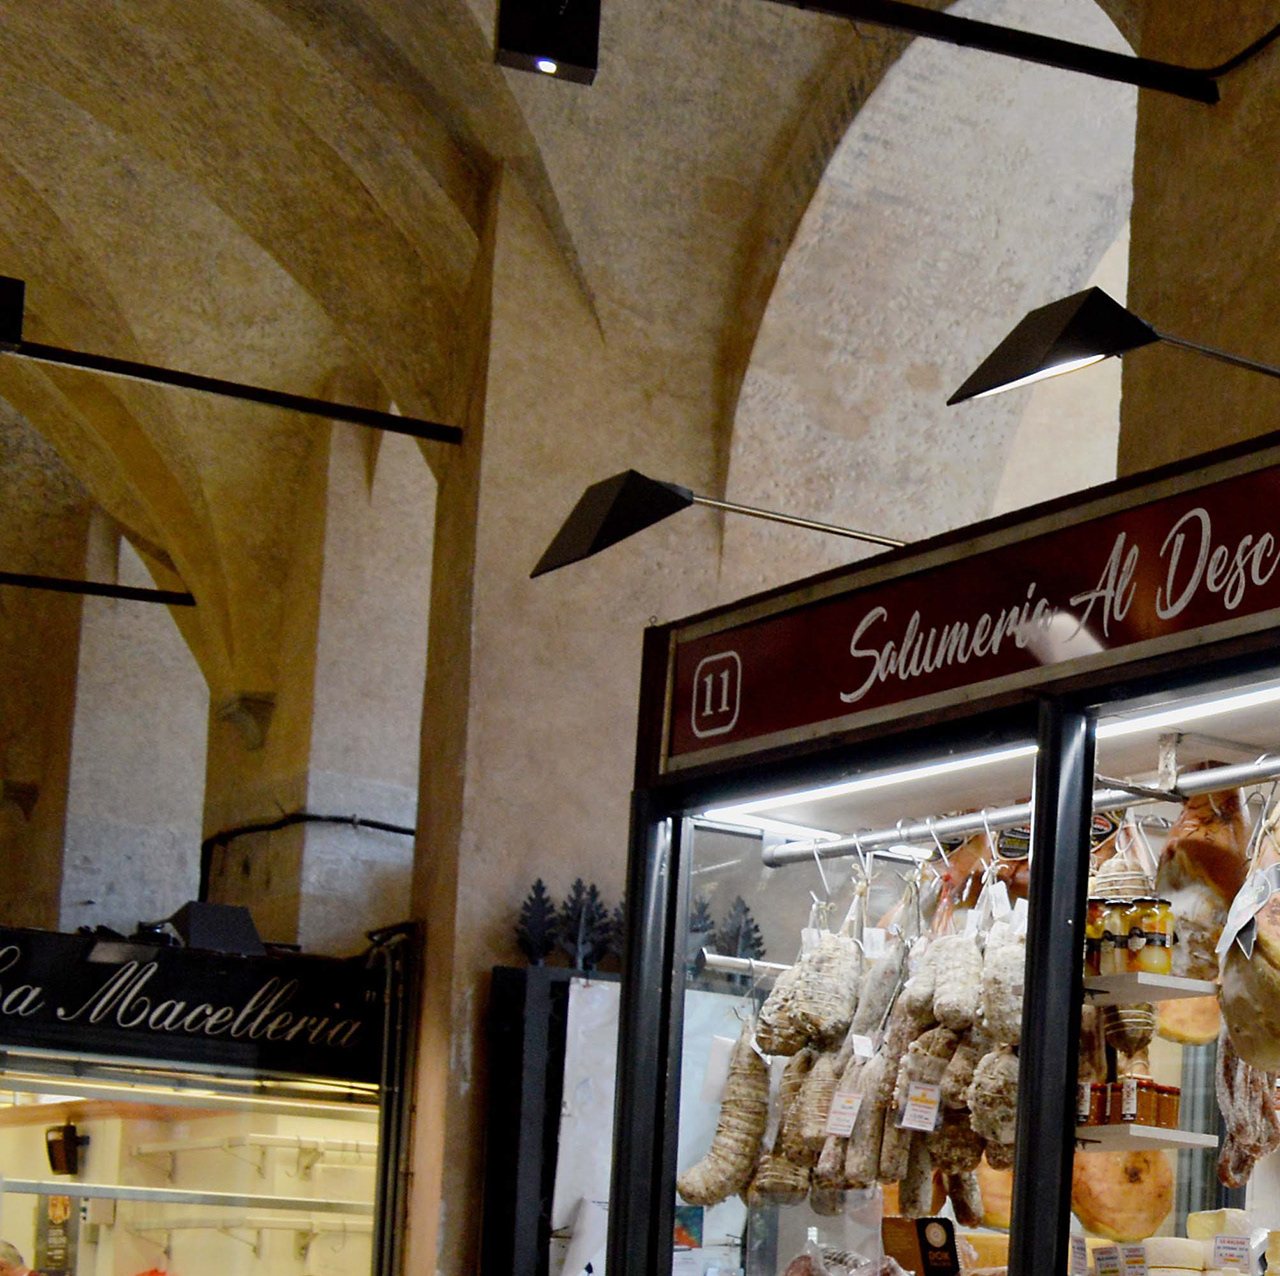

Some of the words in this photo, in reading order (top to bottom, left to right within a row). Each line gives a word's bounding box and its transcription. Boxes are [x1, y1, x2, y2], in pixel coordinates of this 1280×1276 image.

[840, 581, 1059, 703] Salumeria
[1062, 531, 1140, 642] Al
[701, 675, 731, 717] 11
